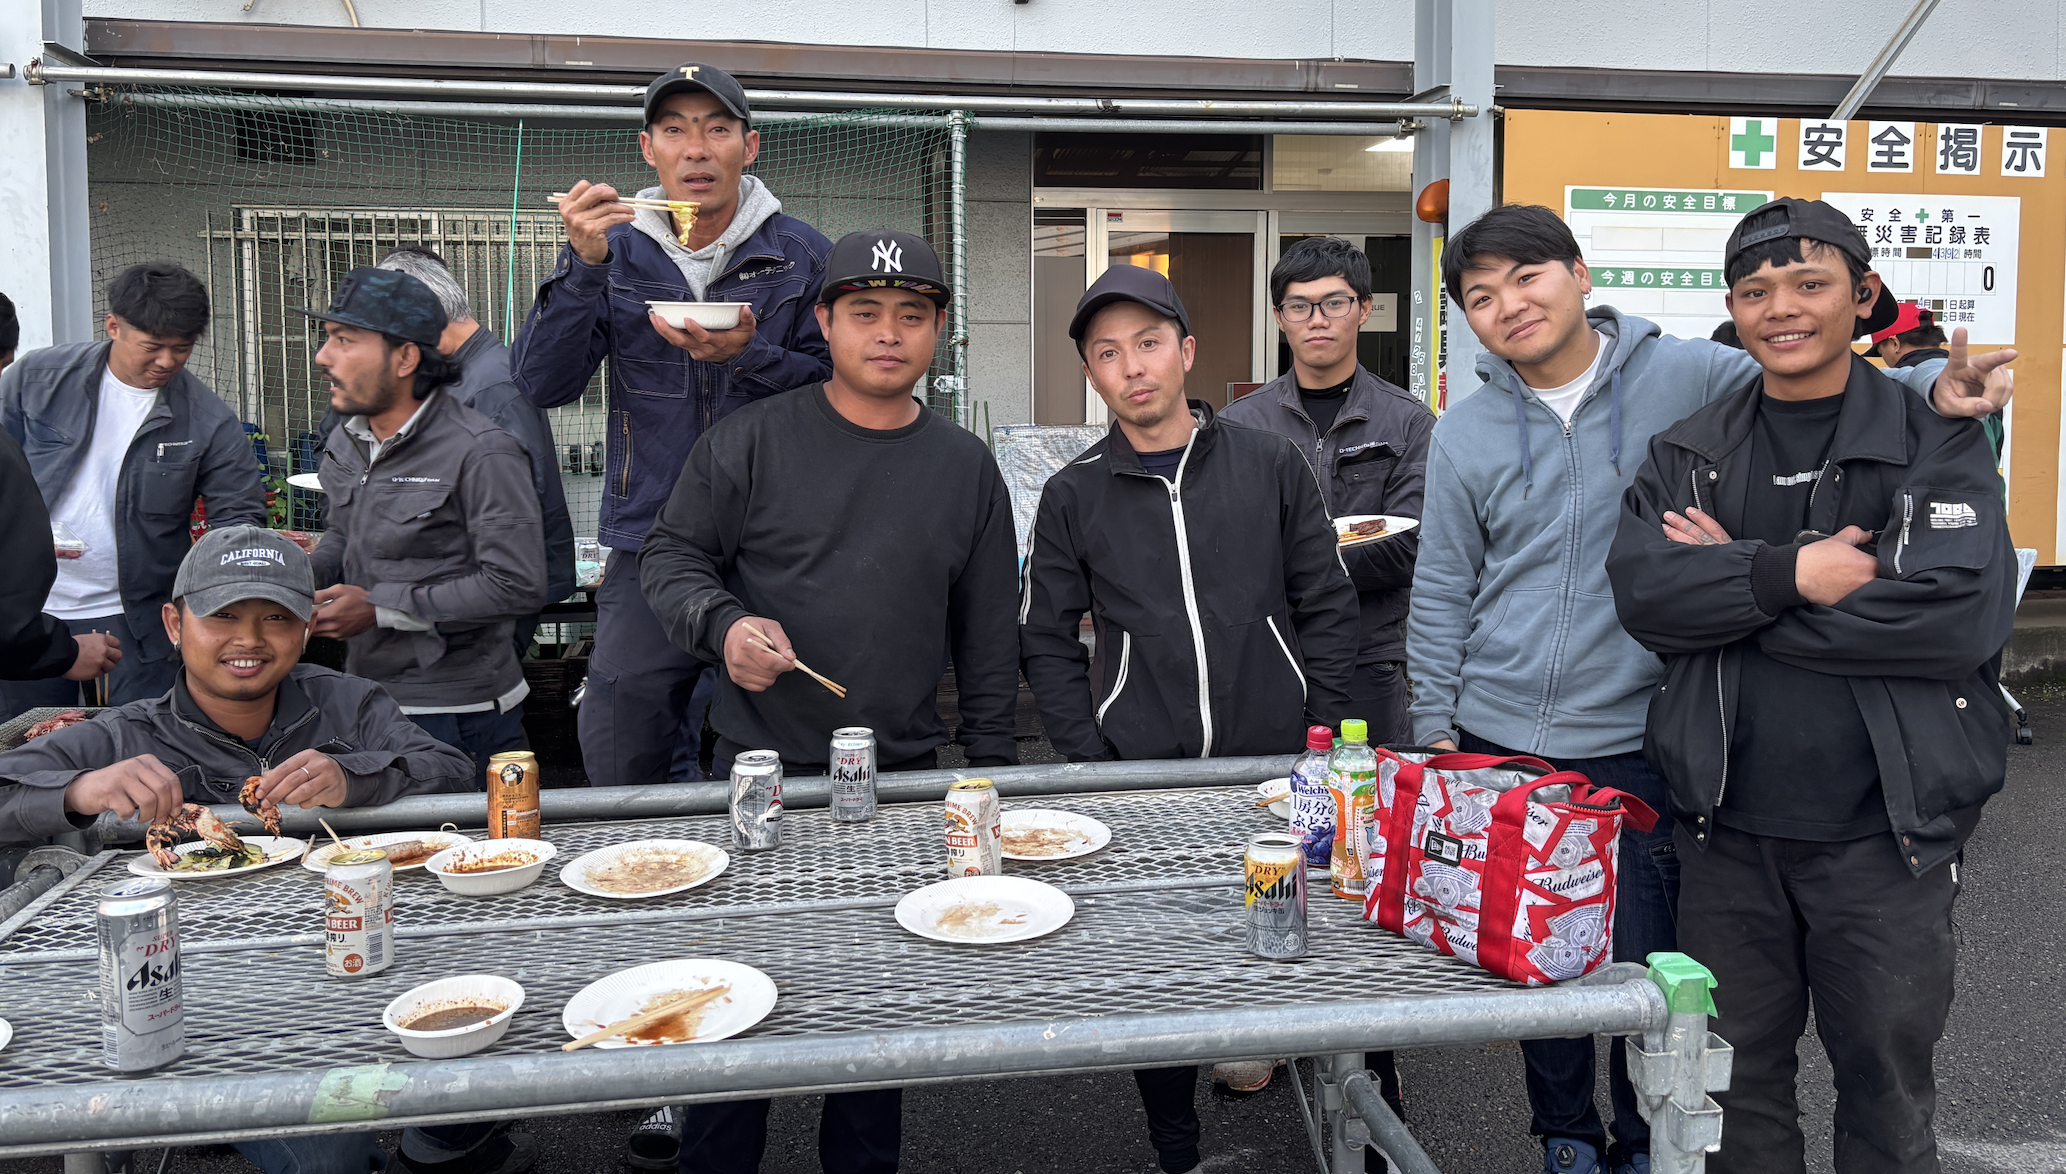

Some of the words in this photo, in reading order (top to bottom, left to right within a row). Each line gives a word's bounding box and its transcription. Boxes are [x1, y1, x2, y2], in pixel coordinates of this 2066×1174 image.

[680, 66, 699, 80] T
[1803, 123, 2042, 172] 安全掲示
[1603, 192, 1736, 211] 今月の安全目標
[871, 239, 903, 272] NY
[1983, 266, 1994, 291] 0
[220, 548, 286, 566] CALIFORNIA
[833, 765, 870, 782] Asahi
[1298, 784, 1329, 795] Welch's
[1293, 812, 1332, 832] ぶどう
[952, 838, 975, 846] BEER
[1246, 872, 1297, 900] Asahi
[330, 919, 358, 929] BEER
[159, 987, 173, 1001] 生
[640, 1123, 672, 1131] adidas
